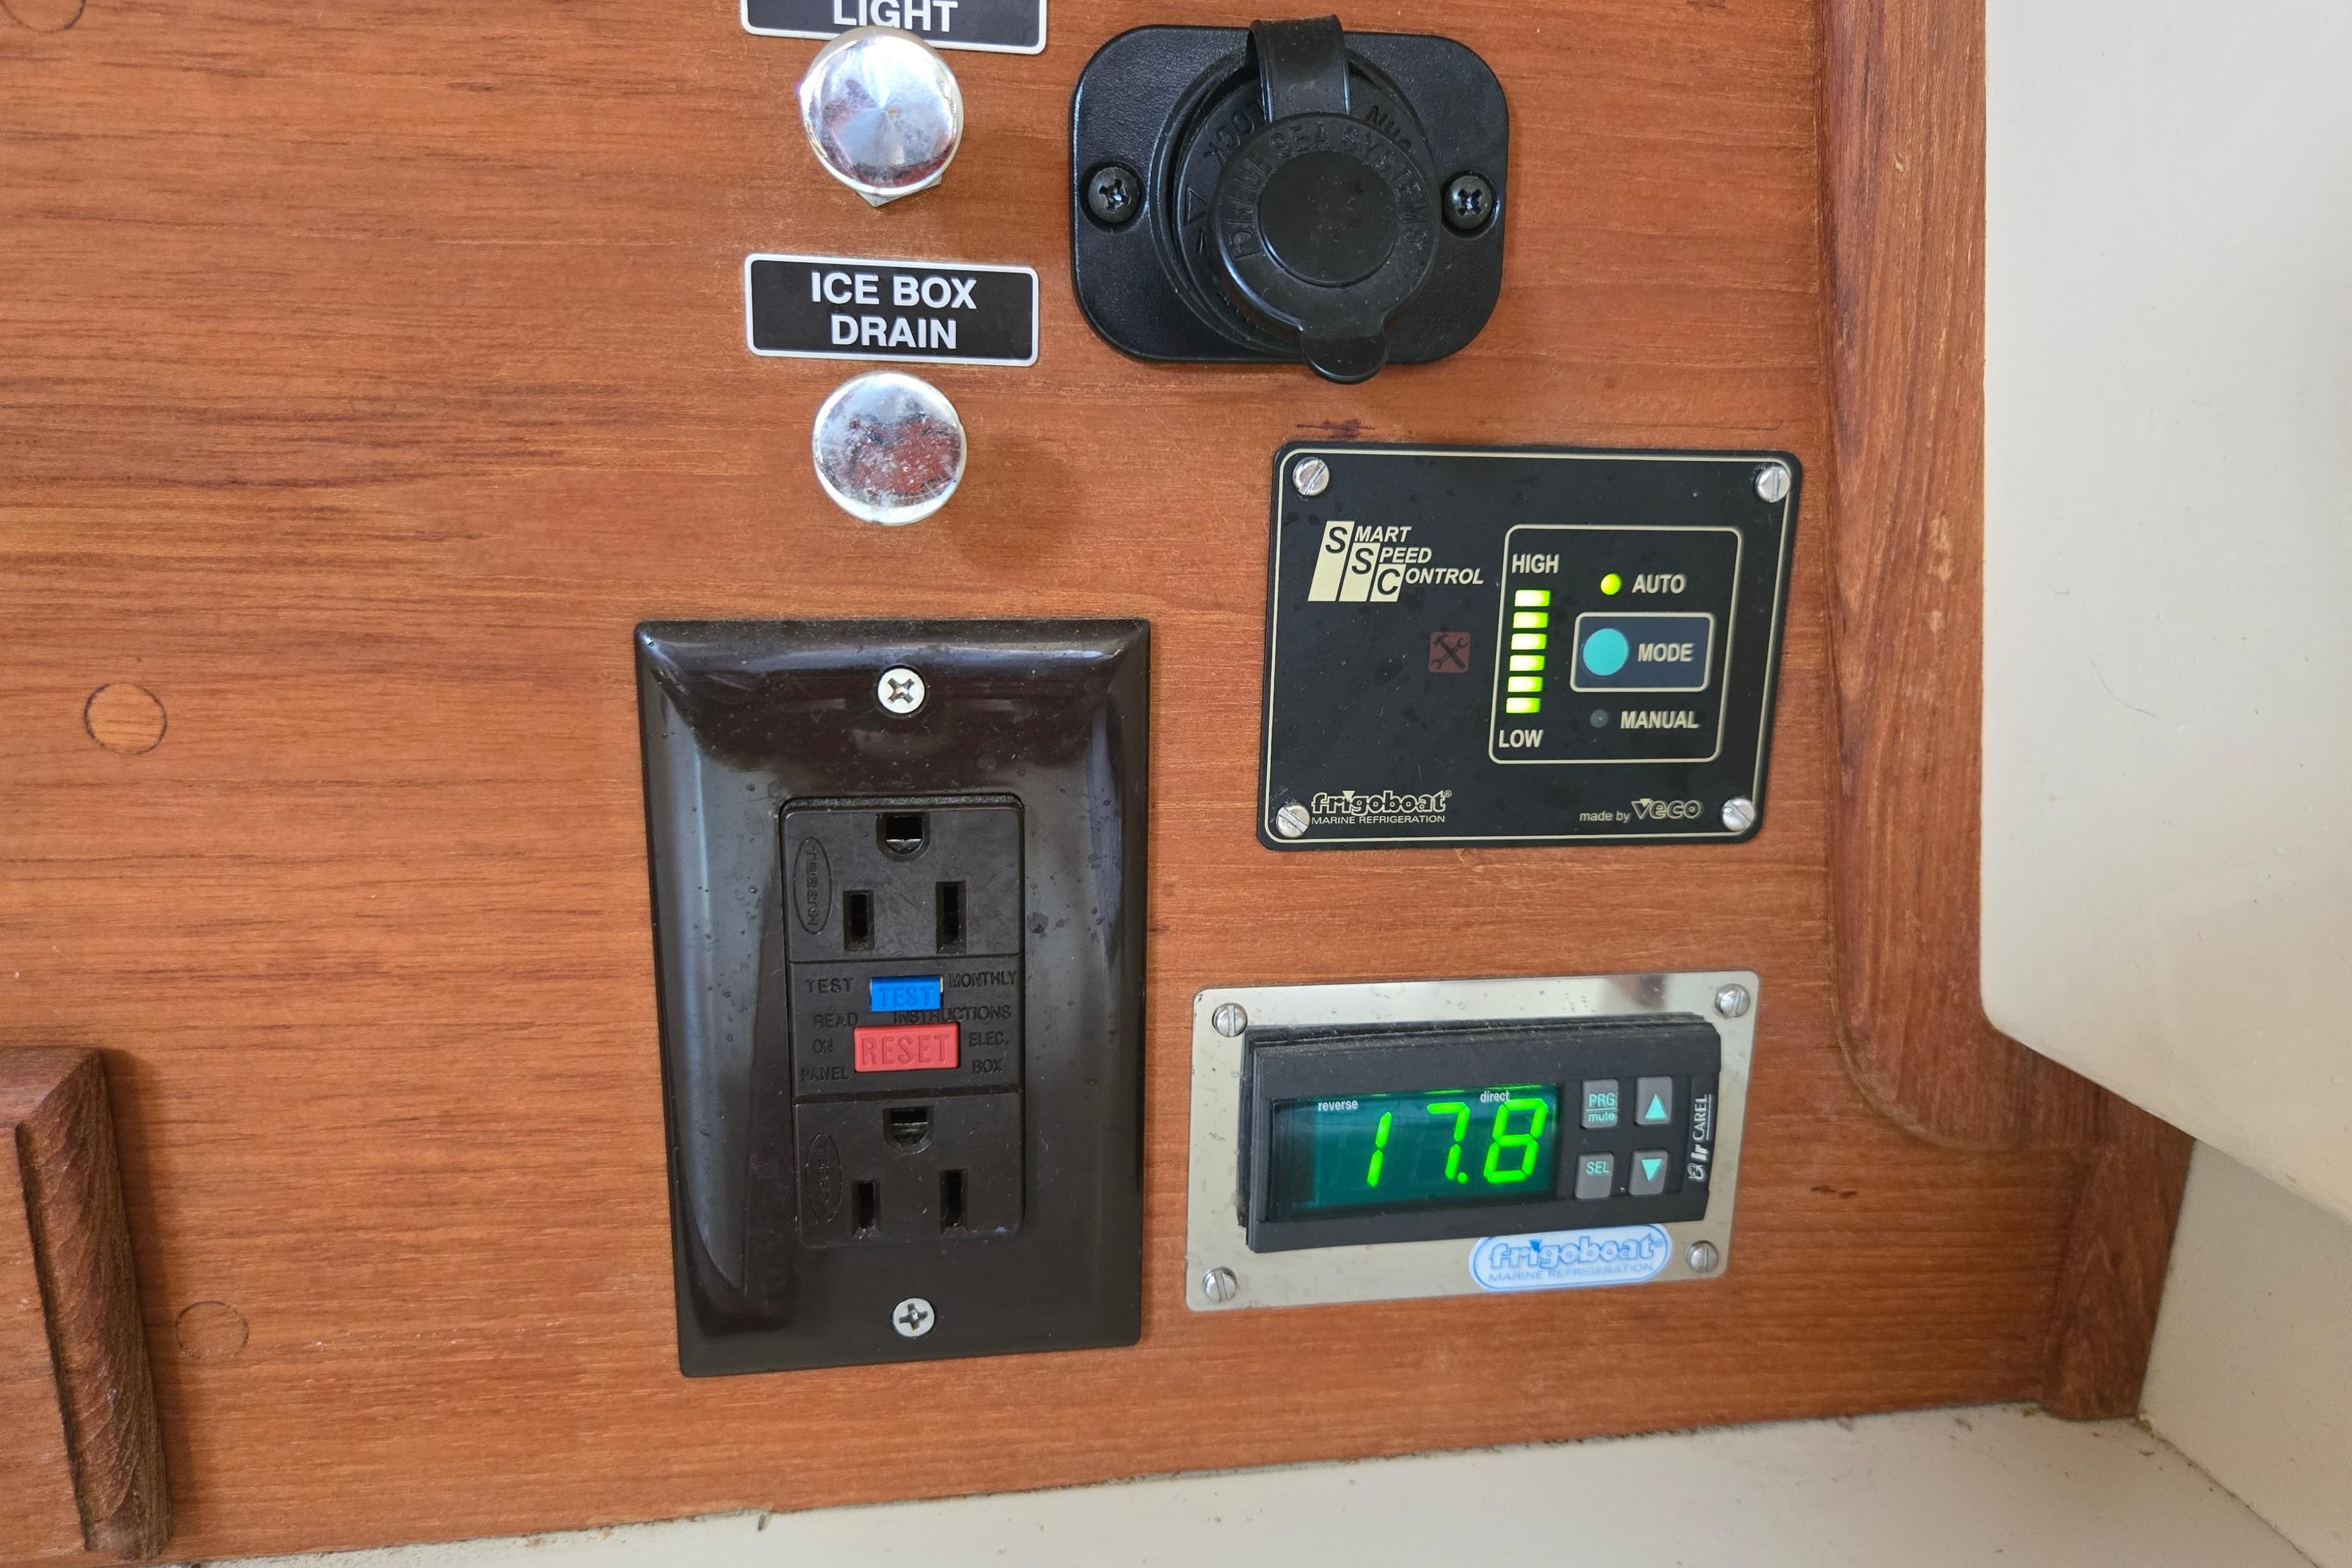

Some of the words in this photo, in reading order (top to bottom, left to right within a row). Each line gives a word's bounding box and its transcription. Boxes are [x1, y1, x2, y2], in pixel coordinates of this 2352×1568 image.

[834, 0, 959, 32] LIGHT
[1226, 153, 1273, 225] BLUE
[1270, 123, 1332, 160] SEA
[810, 271, 880, 306] ICE
[892, 274, 978, 310] BOX
[830, 314, 957, 350] DRAIN
[1325, 526, 1412, 554] SMART
[1351, 547, 1432, 575] SPEED
[1511, 553, 1560, 574] HIGH
[1378, 568, 1485, 595] CONTROL
[1631, 573, 1686, 594] AUTO
[1637, 643, 1695, 663] MODE
[1620, 710, 1700, 729] MANUAL
[1498, 729, 1544, 748] LOW
[1311, 816, 1355, 824] MARINE
[1359, 815, 1446, 824] REFRIGERATION
[1579, 810, 1613, 821] made
[1616, 810, 1630, 824] by
[805, 978, 854, 994] TEST
[949, 970, 1018, 988] MONTHLY
[878, 986, 935, 1008] TEST
[813, 1012, 859, 1028] READ
[893, 1005, 1012, 1024] INSTRUCTIONS
[813, 1038, 834, 1054] ON
[861, 1034, 950, 1066] RESET
[800, 1066, 849, 1082] PANEL
[972, 1058, 1005, 1074] BOX
[1317, 1099, 1359, 1112] reverse
[1480, 1090, 1511, 1102] direct
[1588, 1092, 1616, 1108] PRG
[1588, 1111, 1616, 1123] mute
[1692, 1094, 1708, 1141] CAREL
[1366, 1098, 1549, 1188] 17.8
[1586, 1161, 1612, 1175] SEL
[1488, 1268, 1544, 1283] MARINE
[1548, 1262, 1653, 1279] REFRIGERATION
